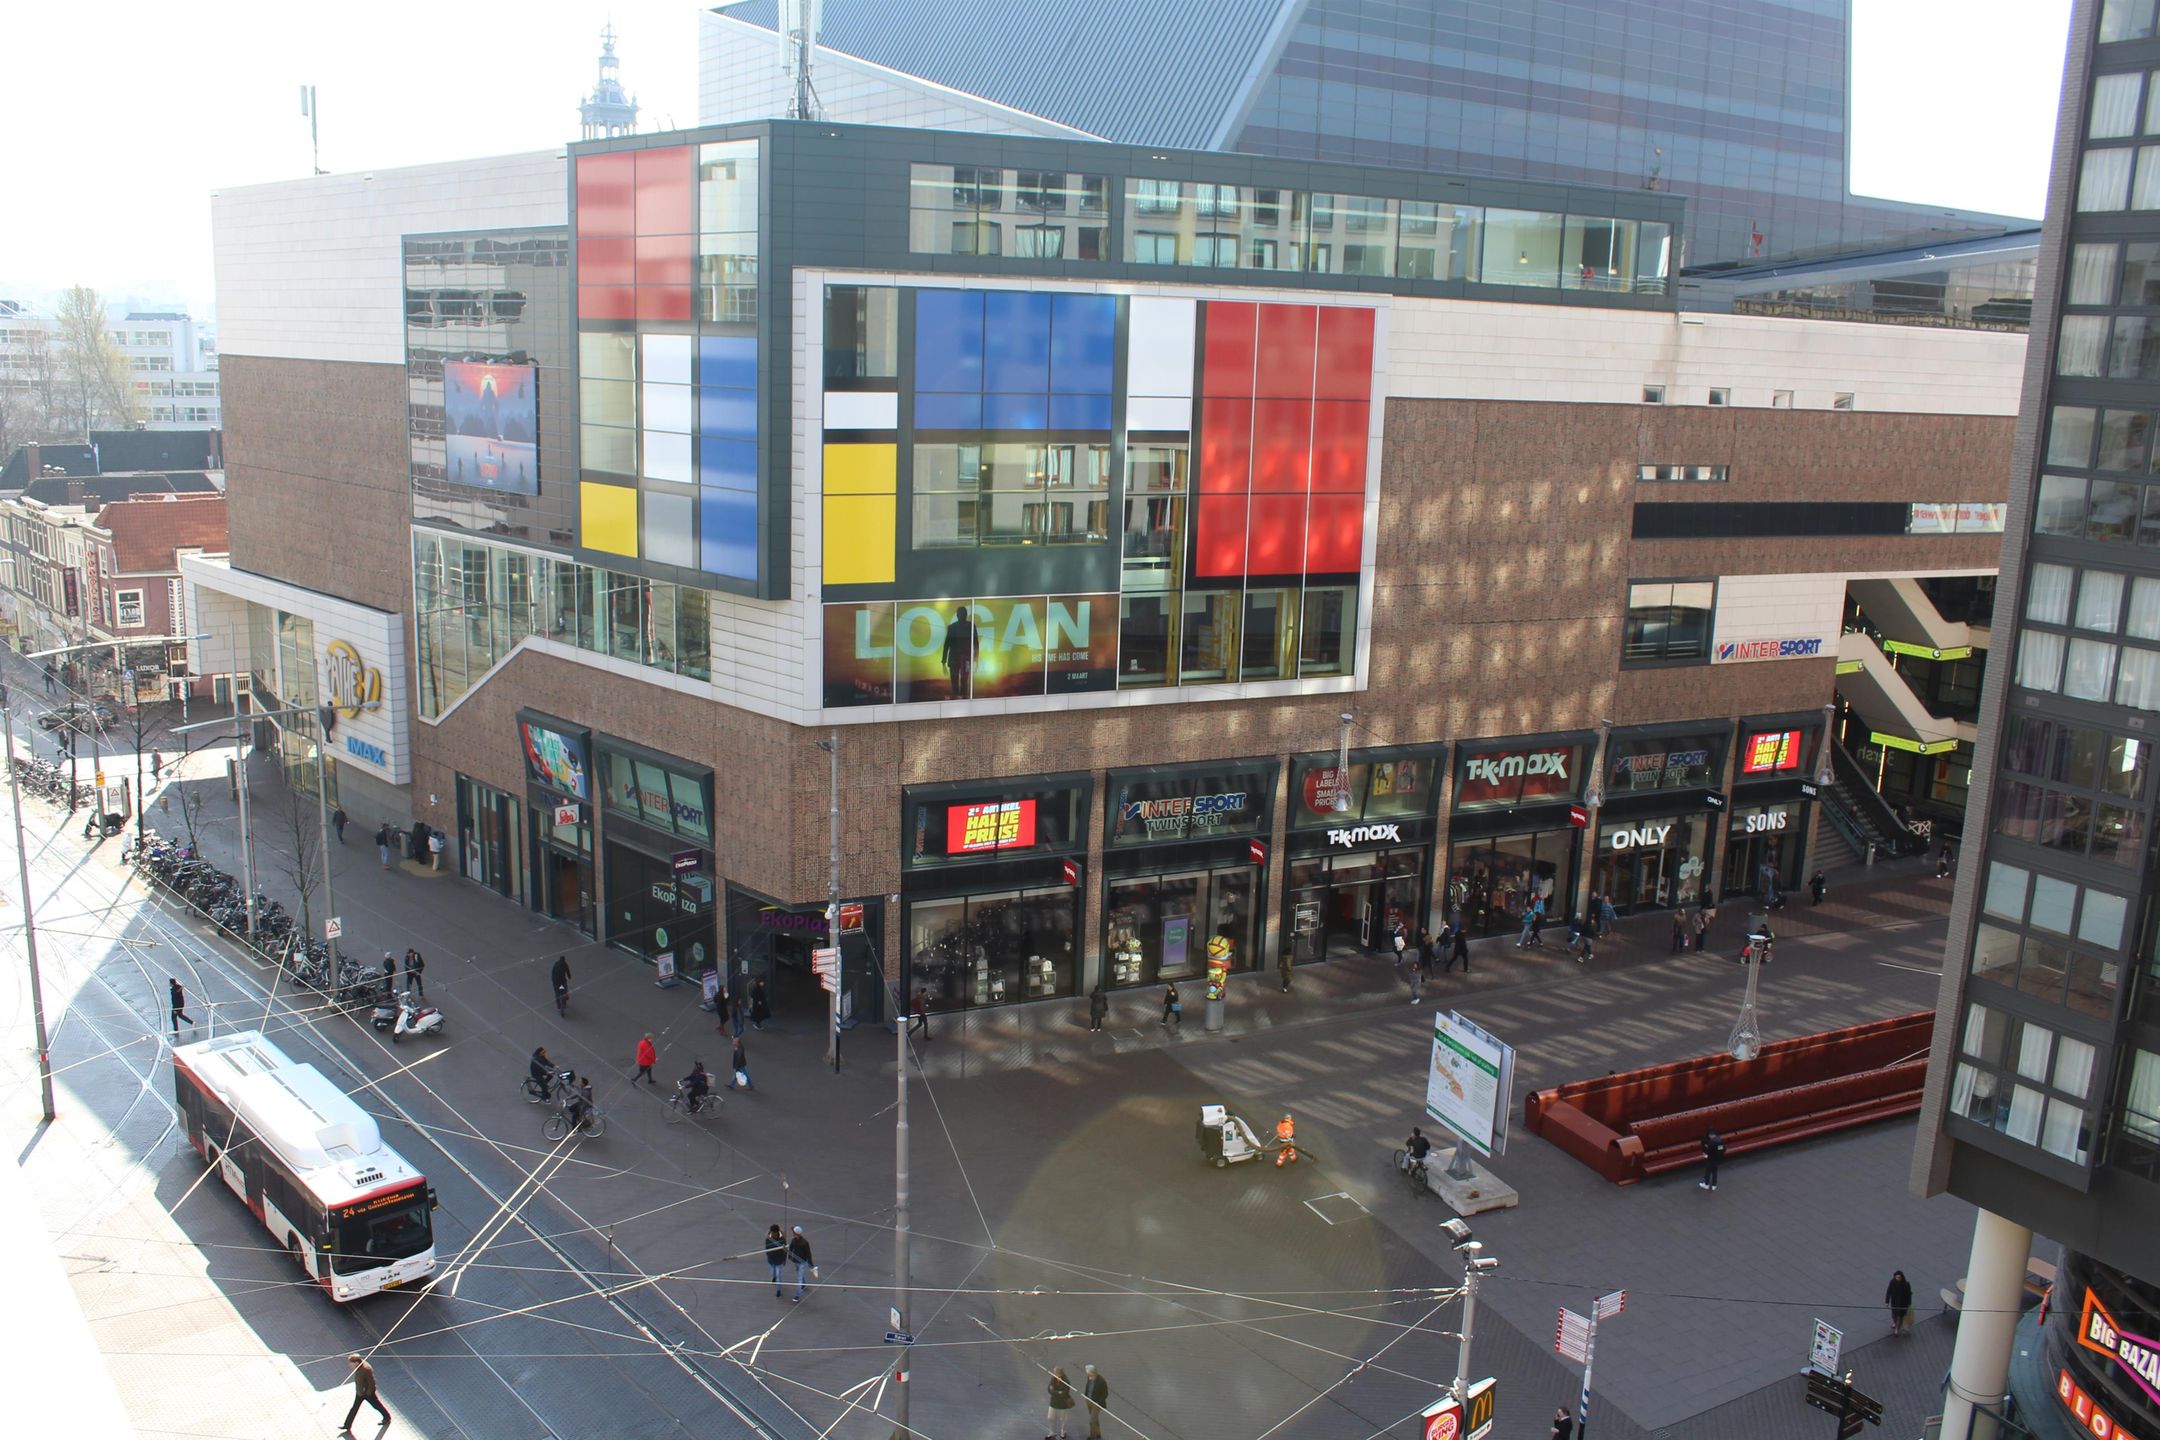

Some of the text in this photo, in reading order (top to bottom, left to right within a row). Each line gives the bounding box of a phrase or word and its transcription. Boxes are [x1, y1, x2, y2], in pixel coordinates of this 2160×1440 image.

[855, 601, 1091, 659] LOGAN
[1735, 638, 1823, 658] INTERSPORT
[346, 736, 386, 766] IMAX
[966, 811, 1020, 830] HALVE
[1746, 812, 1787, 833] SONS
[1611, 825, 1671, 850] ONLY
[342, 1208, 355, 1218] 24
[2089, 1312, 2119, 1350] BIG
[2118, 1340, 2160, 1391] BAZA
[2059, 1375, 2127, 1440] BLO
